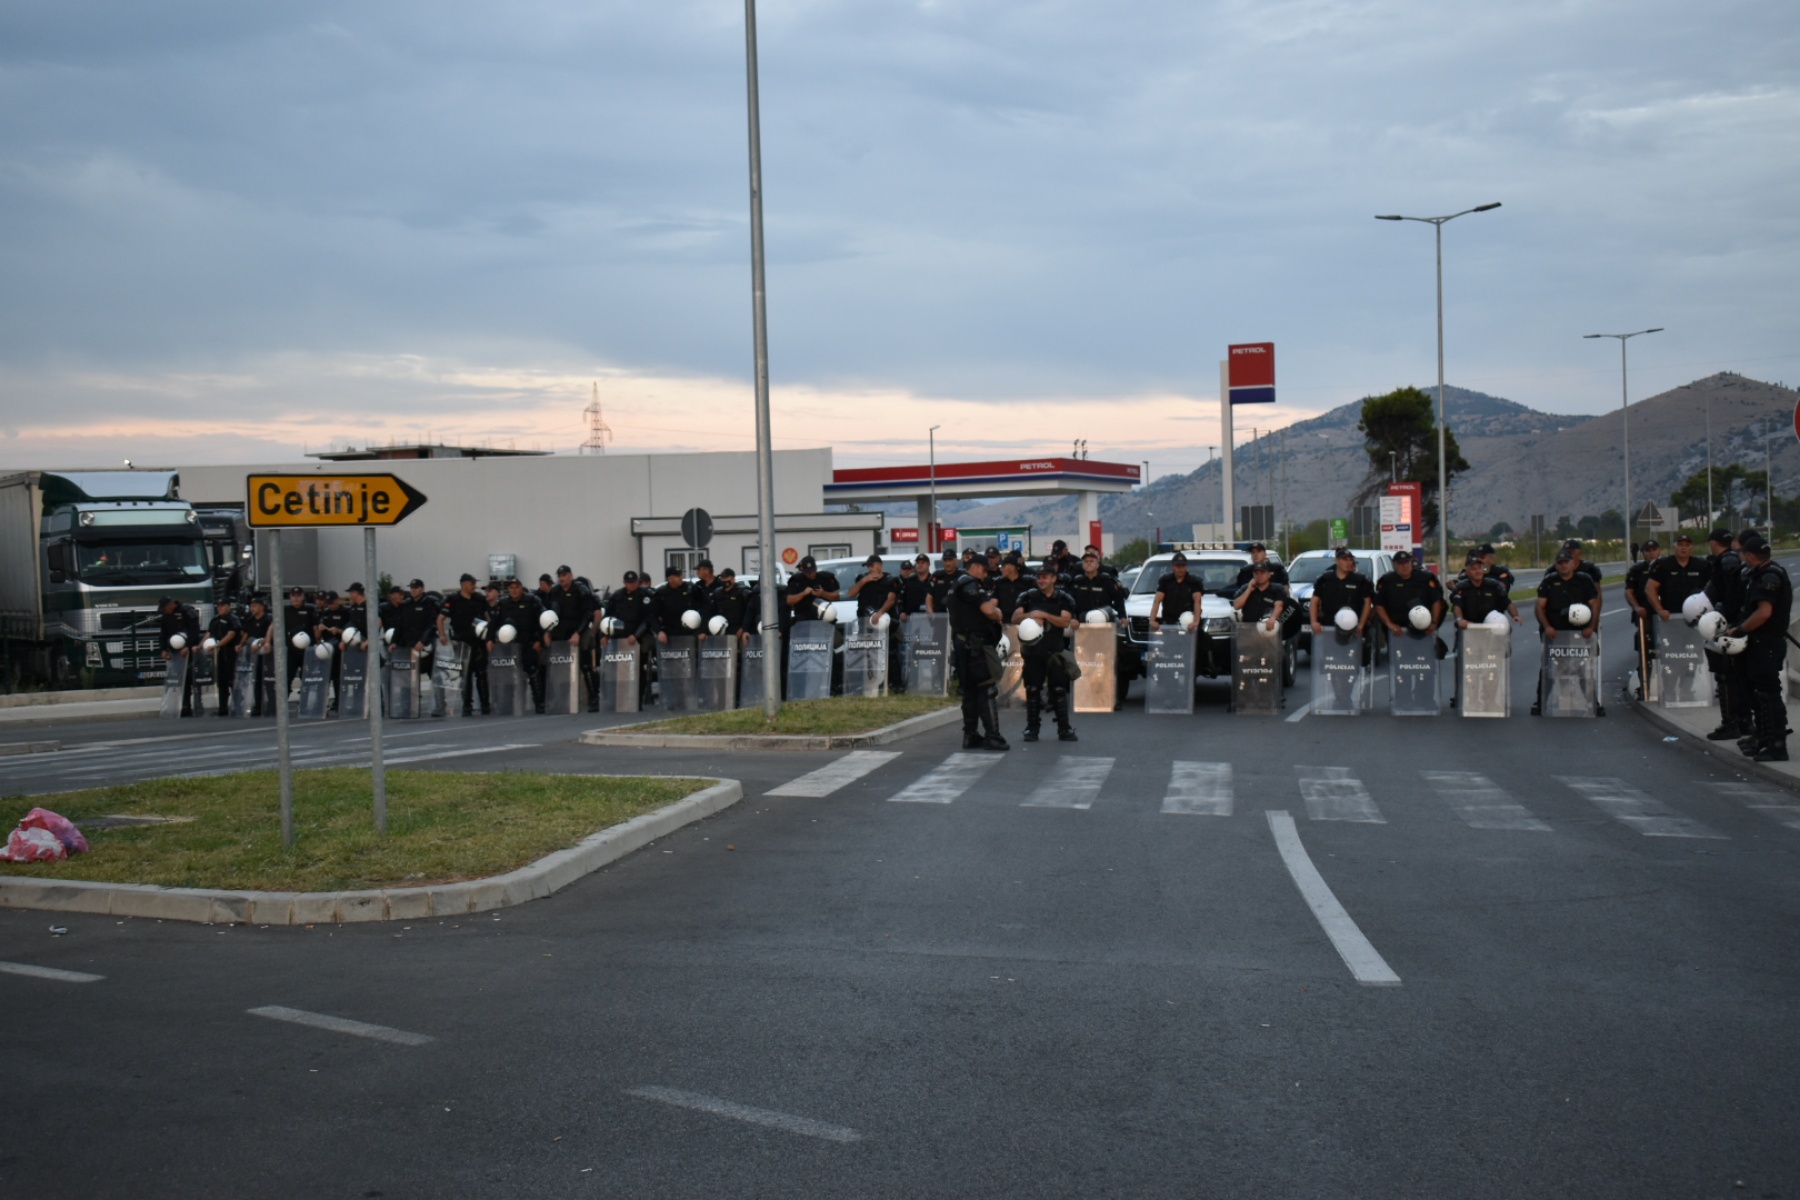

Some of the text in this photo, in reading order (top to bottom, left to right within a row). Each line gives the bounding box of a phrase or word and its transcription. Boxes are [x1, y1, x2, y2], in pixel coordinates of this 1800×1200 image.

[1020, 462, 1055, 470] PETROL
[258, 482, 391, 523] Cetinje
[604, 653, 633, 662] POLICIJA
[746, 650, 763, 659] POLIC
[1550, 648, 1589, 658] POLICIJA
[1465, 662, 1497, 670] POLICIJA
